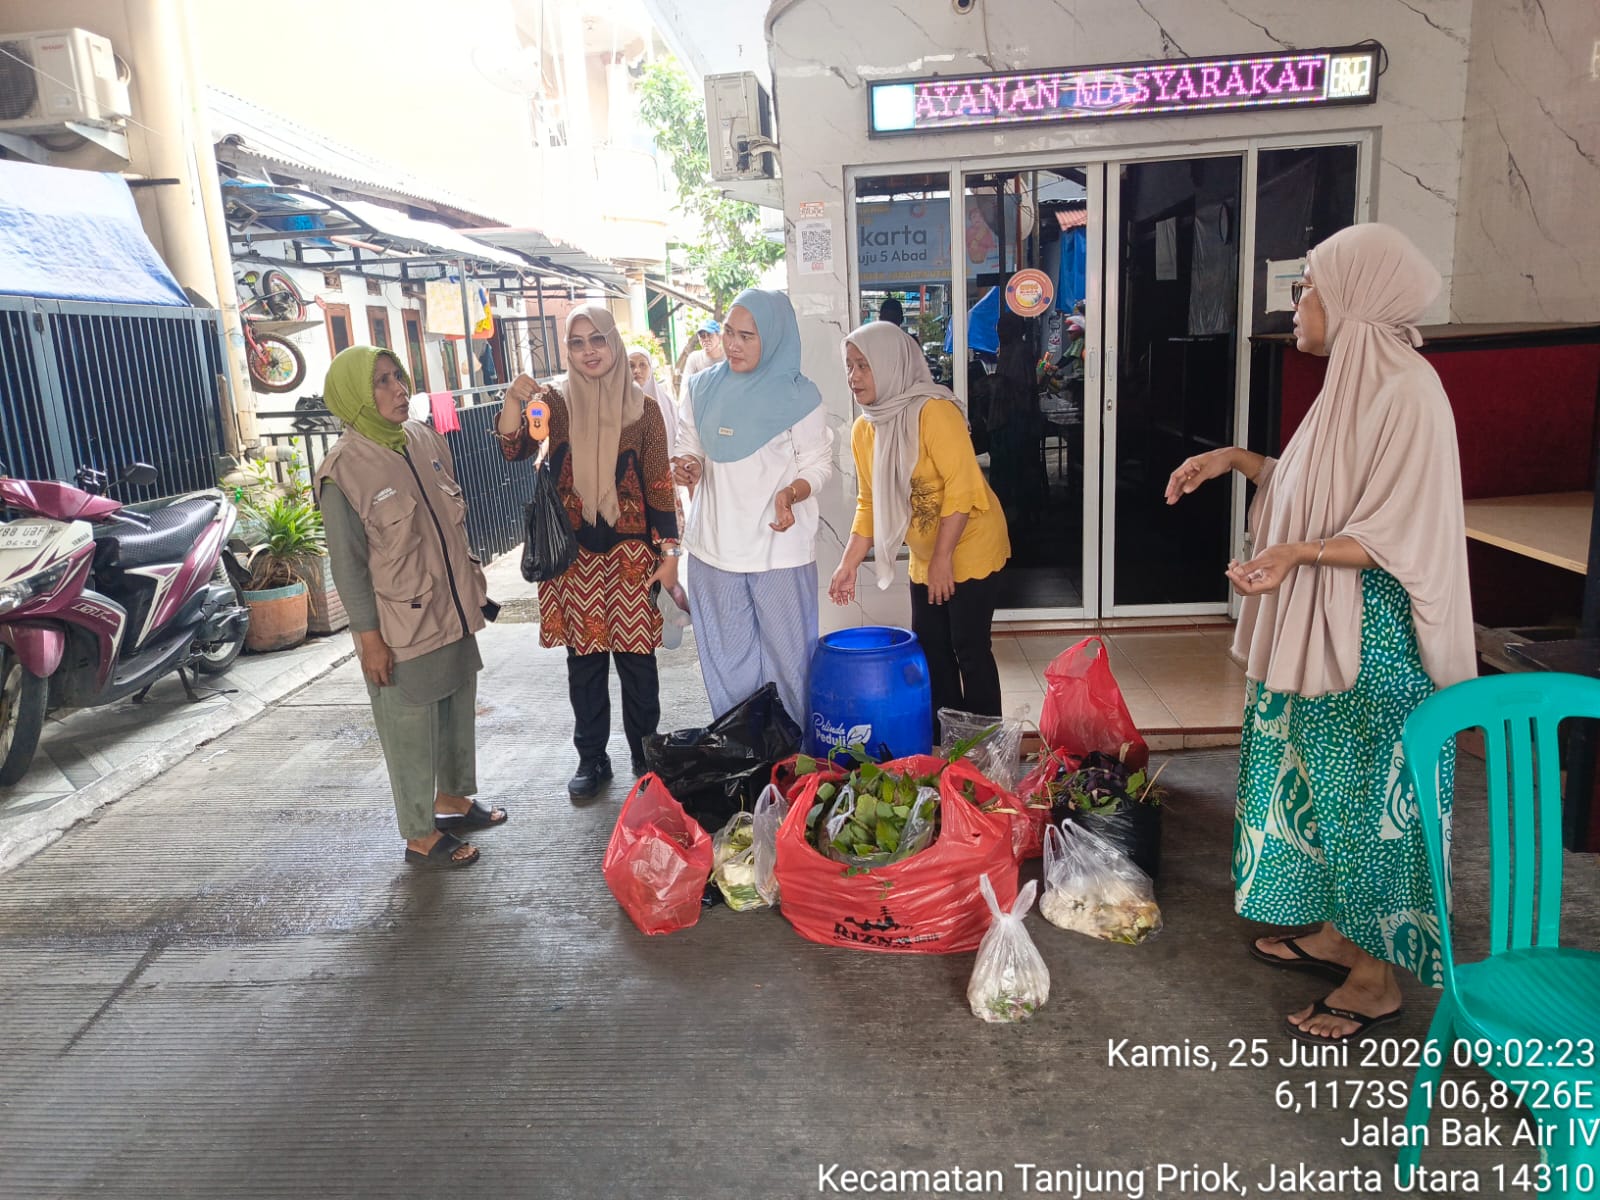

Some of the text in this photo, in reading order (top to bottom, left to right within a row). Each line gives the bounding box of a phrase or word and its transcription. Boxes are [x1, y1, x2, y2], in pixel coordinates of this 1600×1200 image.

[914, 59, 1322, 118] AYANAN MASYARAKAT
[861, 225, 927, 246] karta
[880, 251, 888, 263] 5
[891, 249, 928, 262] Abad
[815, 727, 848, 748] Peduli
